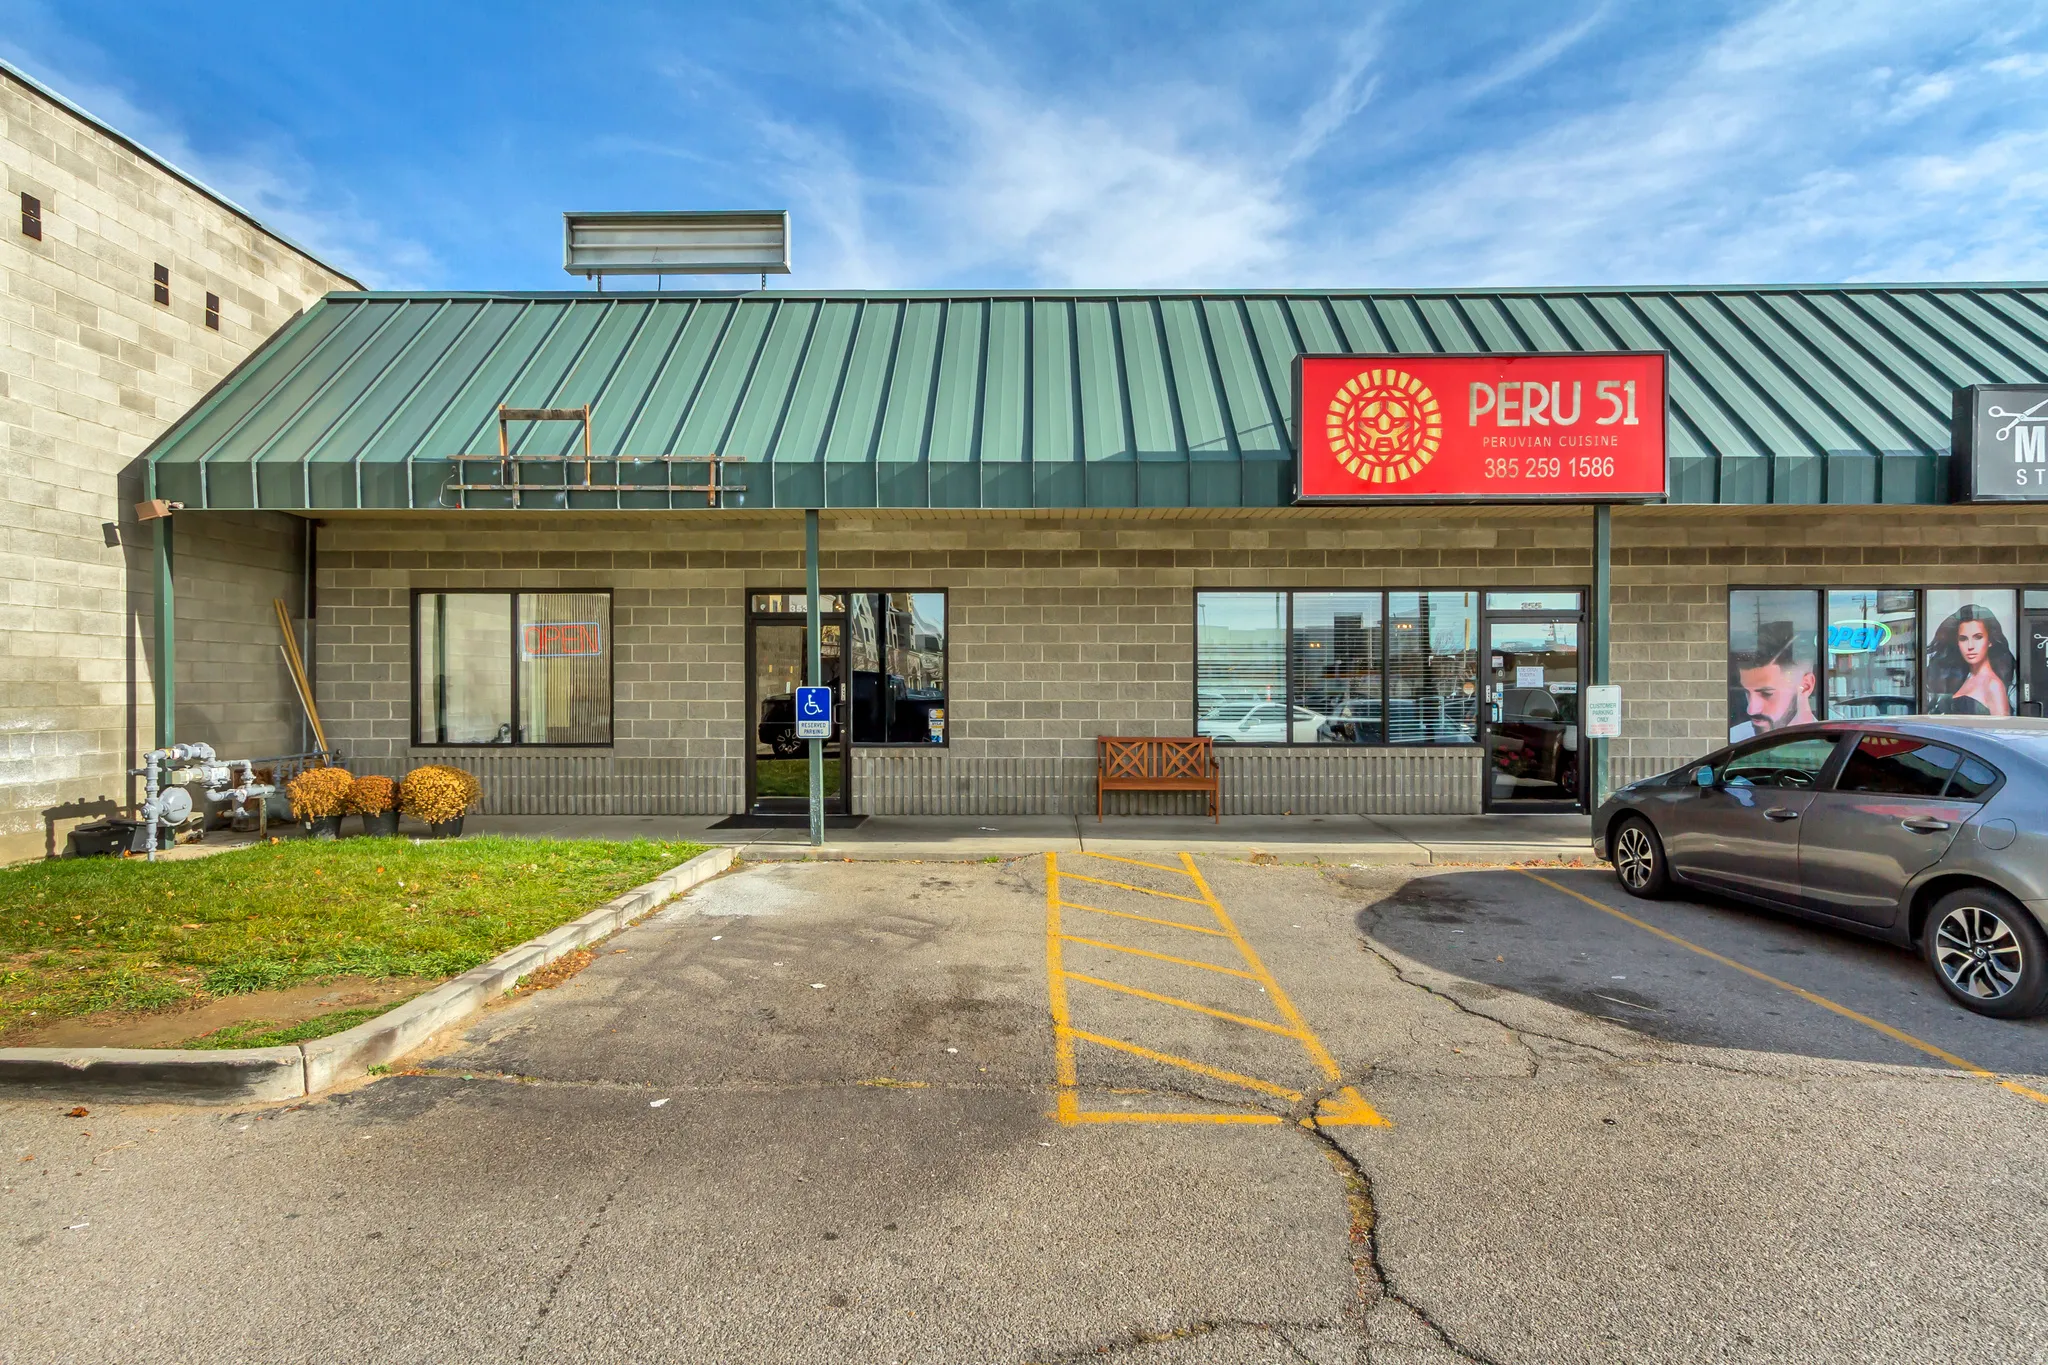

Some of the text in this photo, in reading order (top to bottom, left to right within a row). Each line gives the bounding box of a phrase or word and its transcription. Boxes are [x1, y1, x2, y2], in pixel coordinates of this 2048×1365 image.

[1469, 380, 1639, 427] PERU 51
[1482, 435, 1619, 448] PERUVIAN CUISINE
[1484, 456, 1615, 478] 385 259 1586
[525, 625, 599, 654] OPEN
